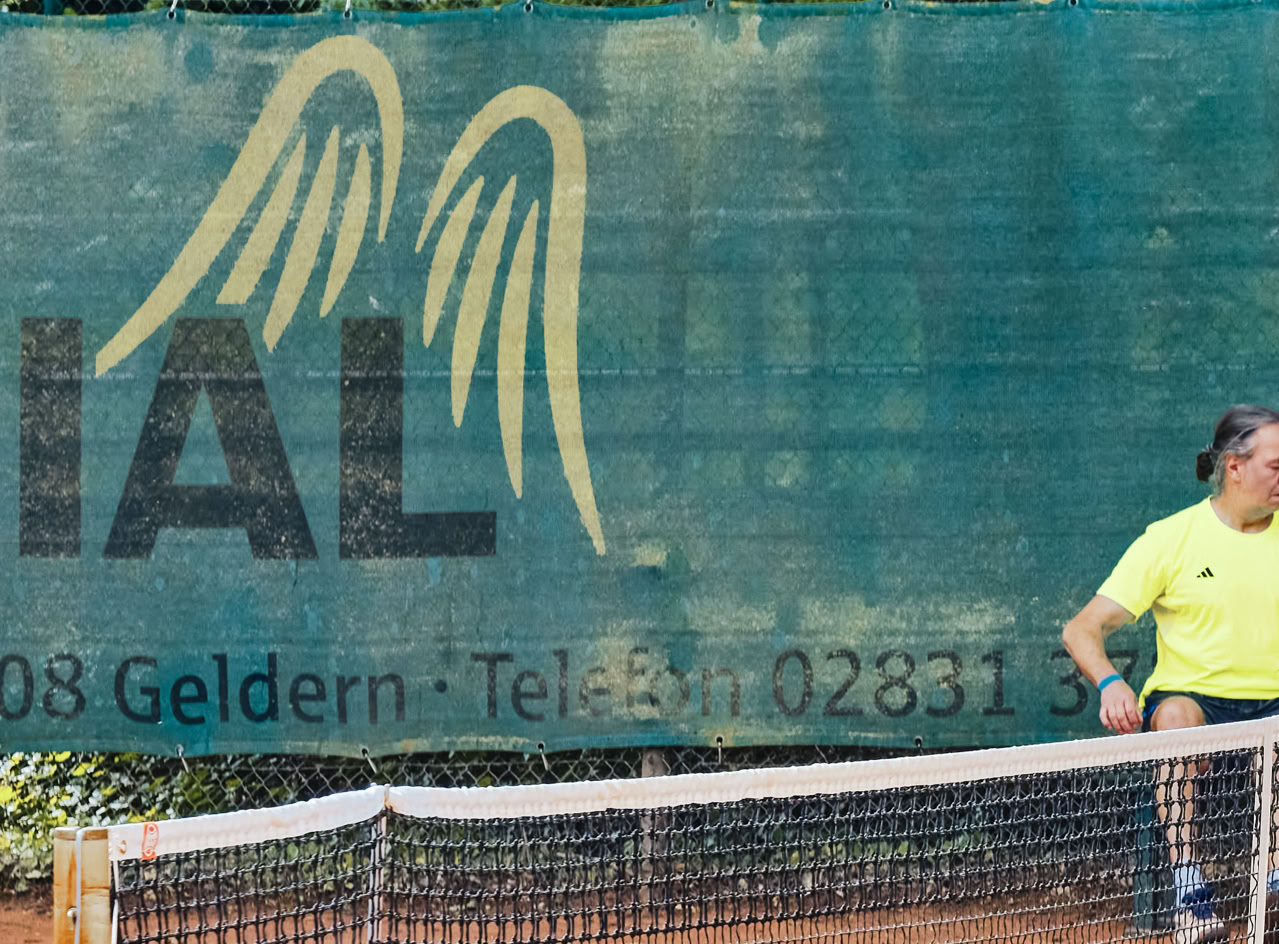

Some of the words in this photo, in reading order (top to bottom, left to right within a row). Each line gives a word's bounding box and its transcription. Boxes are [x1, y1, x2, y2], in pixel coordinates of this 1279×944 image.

[19, 317, 497, 560] IAL
[0, 653, 86, 720] 08
[114, 652, 406, 725] Geldern
[470, 647, 740, 721] Telefon
[771, 649, 1015, 717] 02831
[1050, 648, 1158, 716] 37
